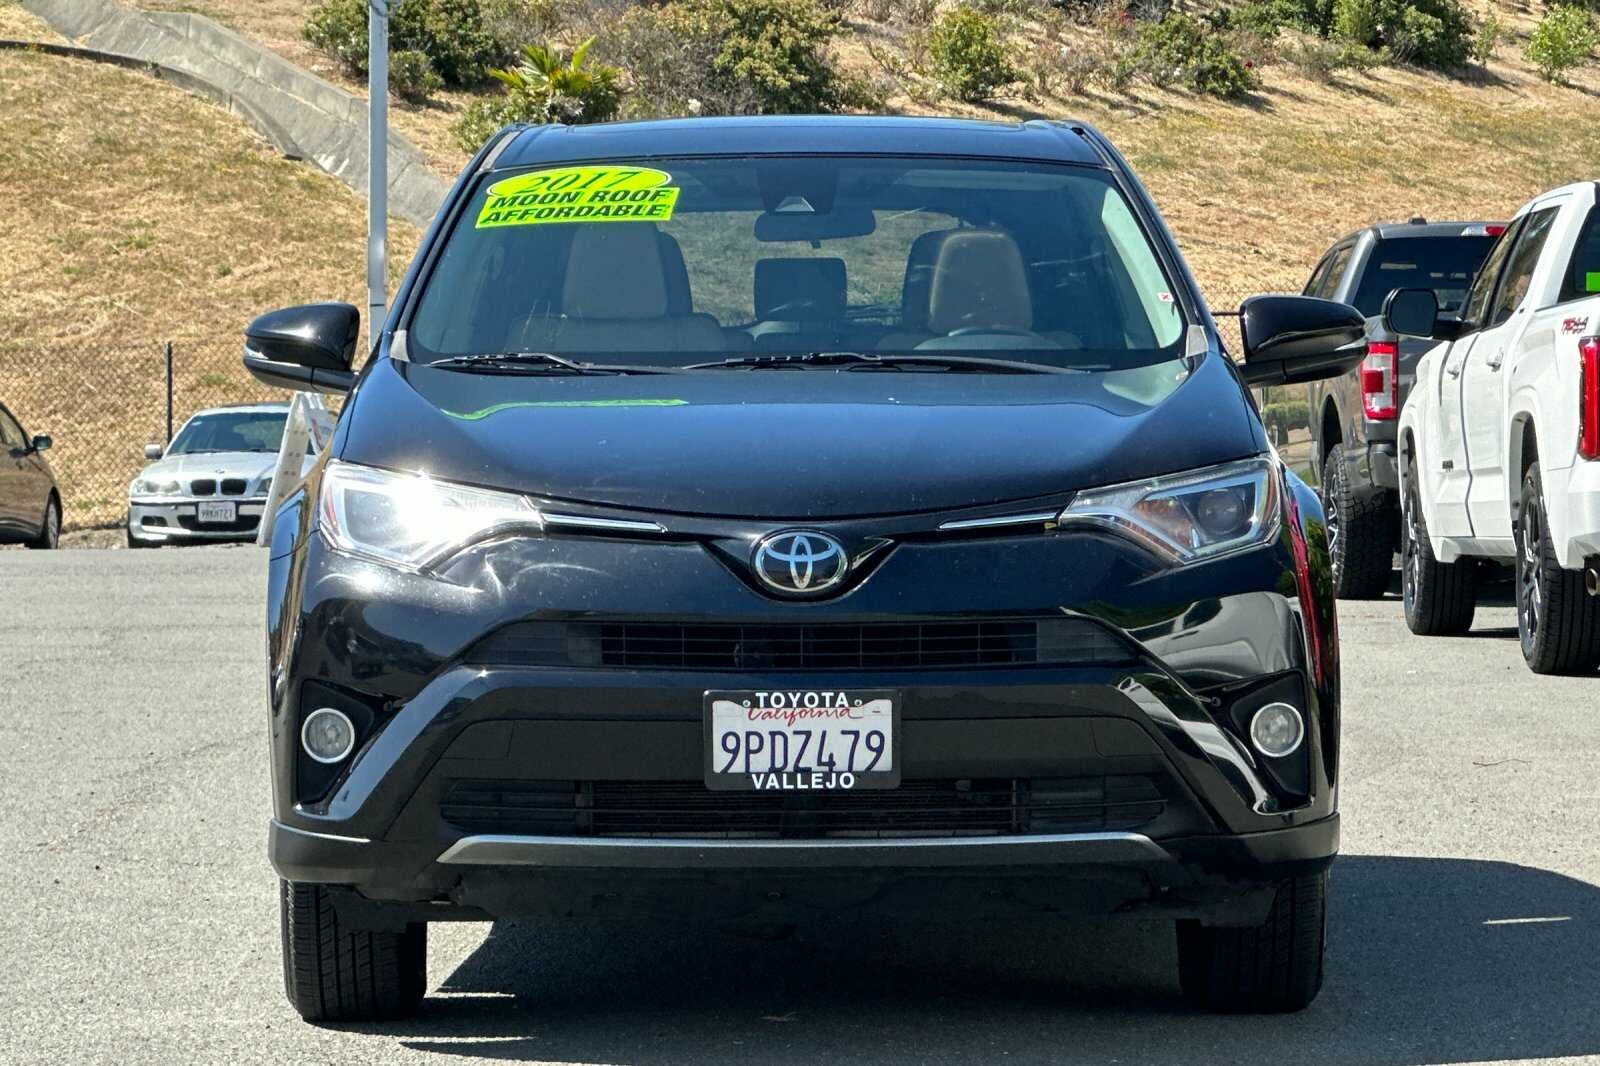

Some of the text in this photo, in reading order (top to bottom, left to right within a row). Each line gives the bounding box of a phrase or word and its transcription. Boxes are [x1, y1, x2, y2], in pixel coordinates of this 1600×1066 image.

[514, 171, 643, 193] 2017
[490, 189, 671, 209] MOON ROOF
[480, 204, 669, 224] AFFORDABLE
[755, 692, 849, 708] TOYOTA
[748, 707, 864, 727] California
[721, 730, 886, 774] 9PDZ479
[752, 772, 855, 790] VALLEJO
